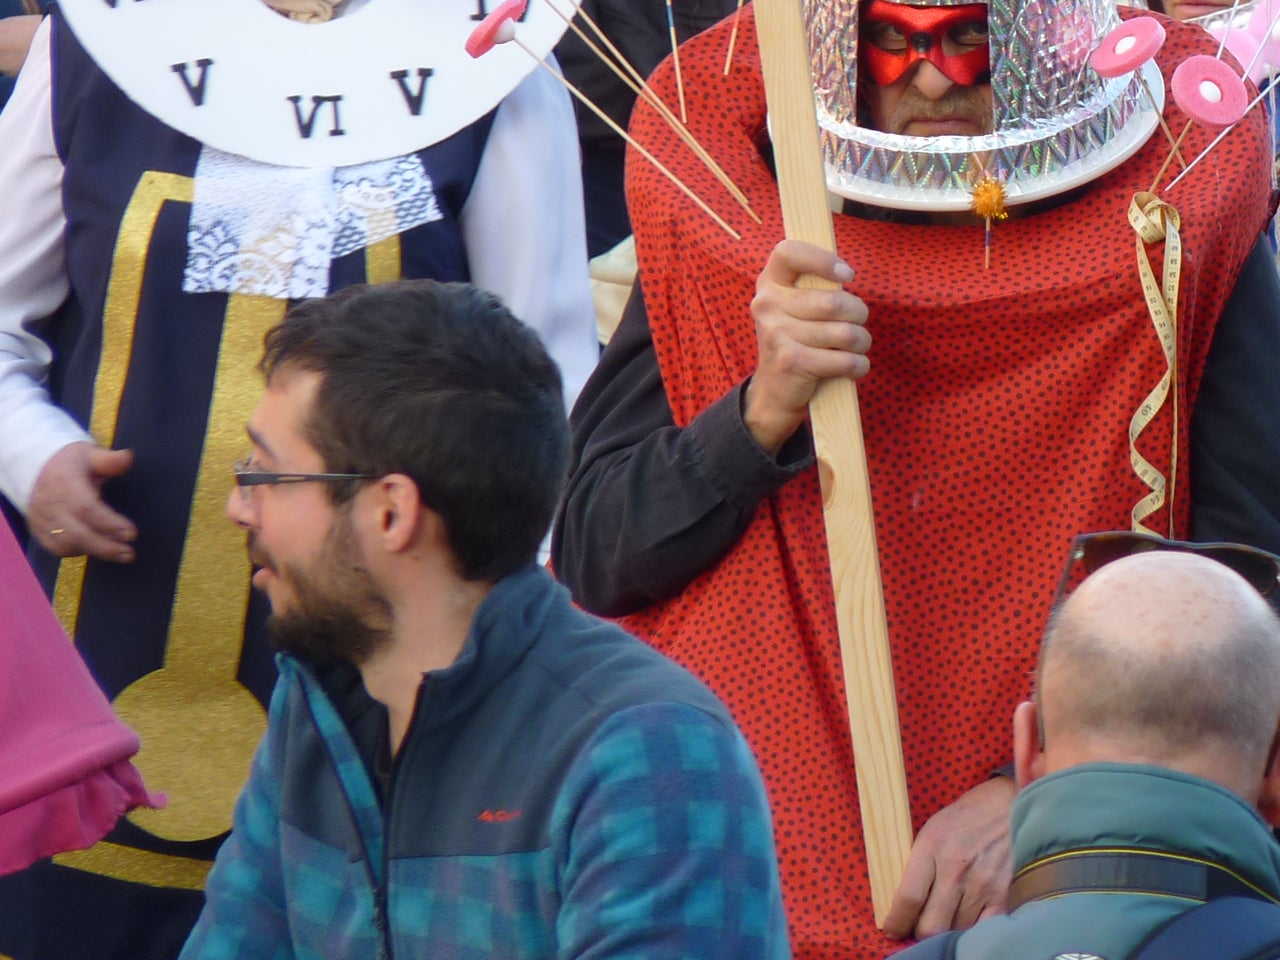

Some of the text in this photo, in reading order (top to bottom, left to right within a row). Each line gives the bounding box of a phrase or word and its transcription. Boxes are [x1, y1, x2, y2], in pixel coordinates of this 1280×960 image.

[172, 59, 212, 106] V
[391, 68, 432, 115] V
[288, 96, 344, 138] VI
